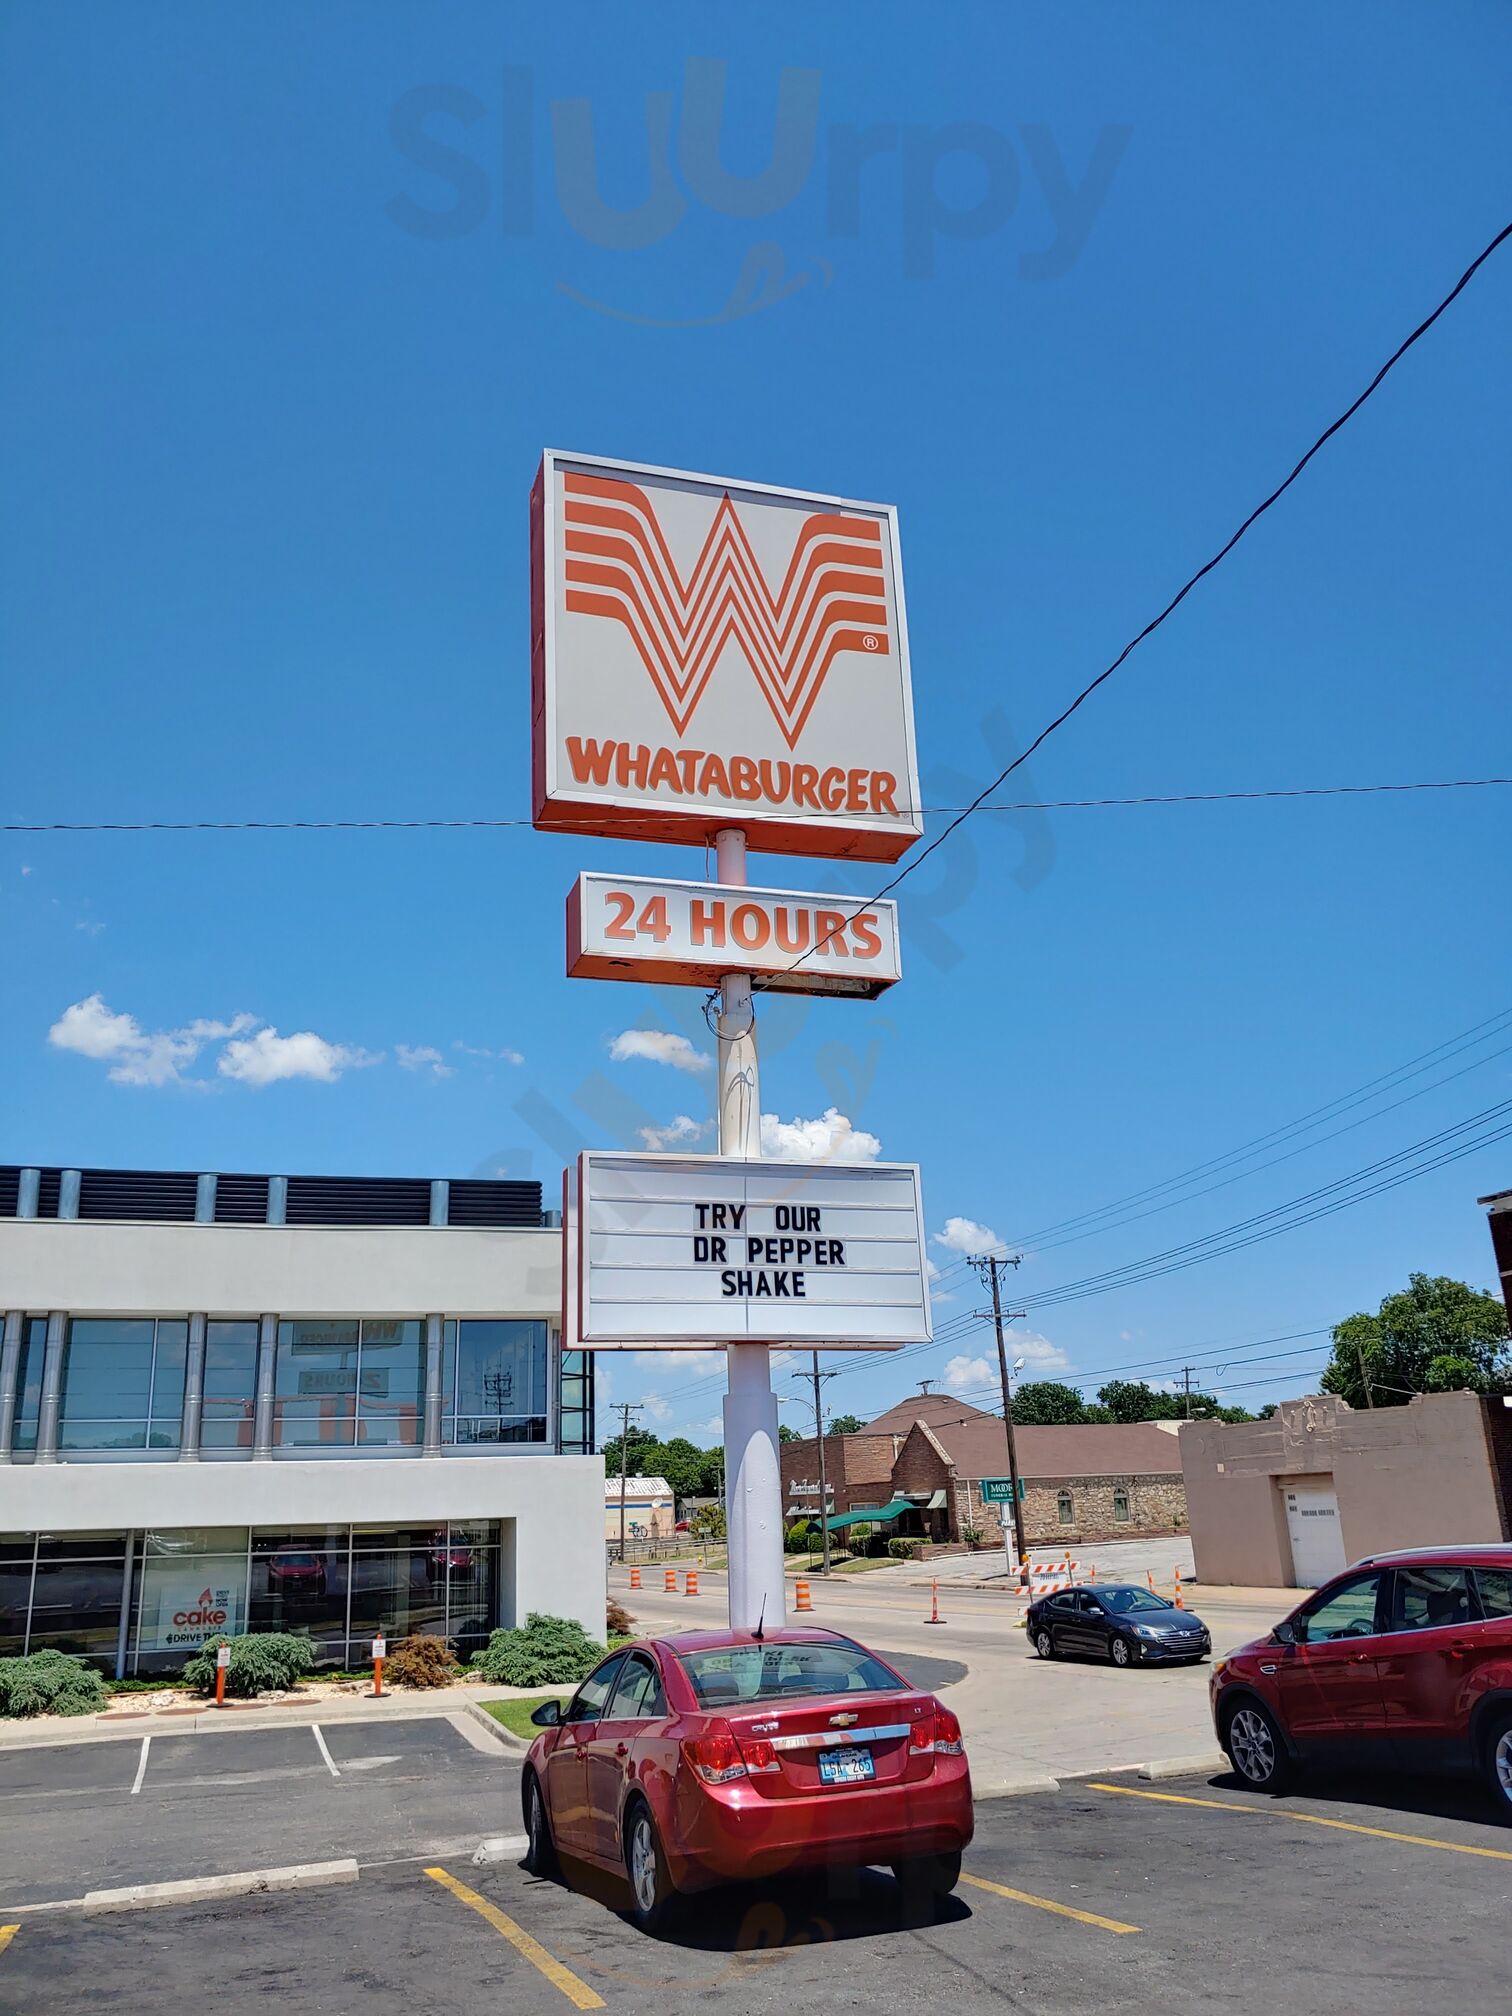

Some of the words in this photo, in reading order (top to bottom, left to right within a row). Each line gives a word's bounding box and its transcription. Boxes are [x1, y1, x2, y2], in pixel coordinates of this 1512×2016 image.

[566, 736, 900, 817] WHATABURGER
[604, 891, 672, 943] 24
[690, 899, 883, 960] HOURS
[695, 1203, 746, 1230] TRY
[775, 1205, 821, 1232] OUR
[694, 1236, 727, 1263] DR
[747, 1237, 845, 1266] PEPPER
[722, 1270, 806, 1297] SHAKE
[173, 1606, 227, 1627] cake
[173, 1632, 202, 1643] DRIVE
